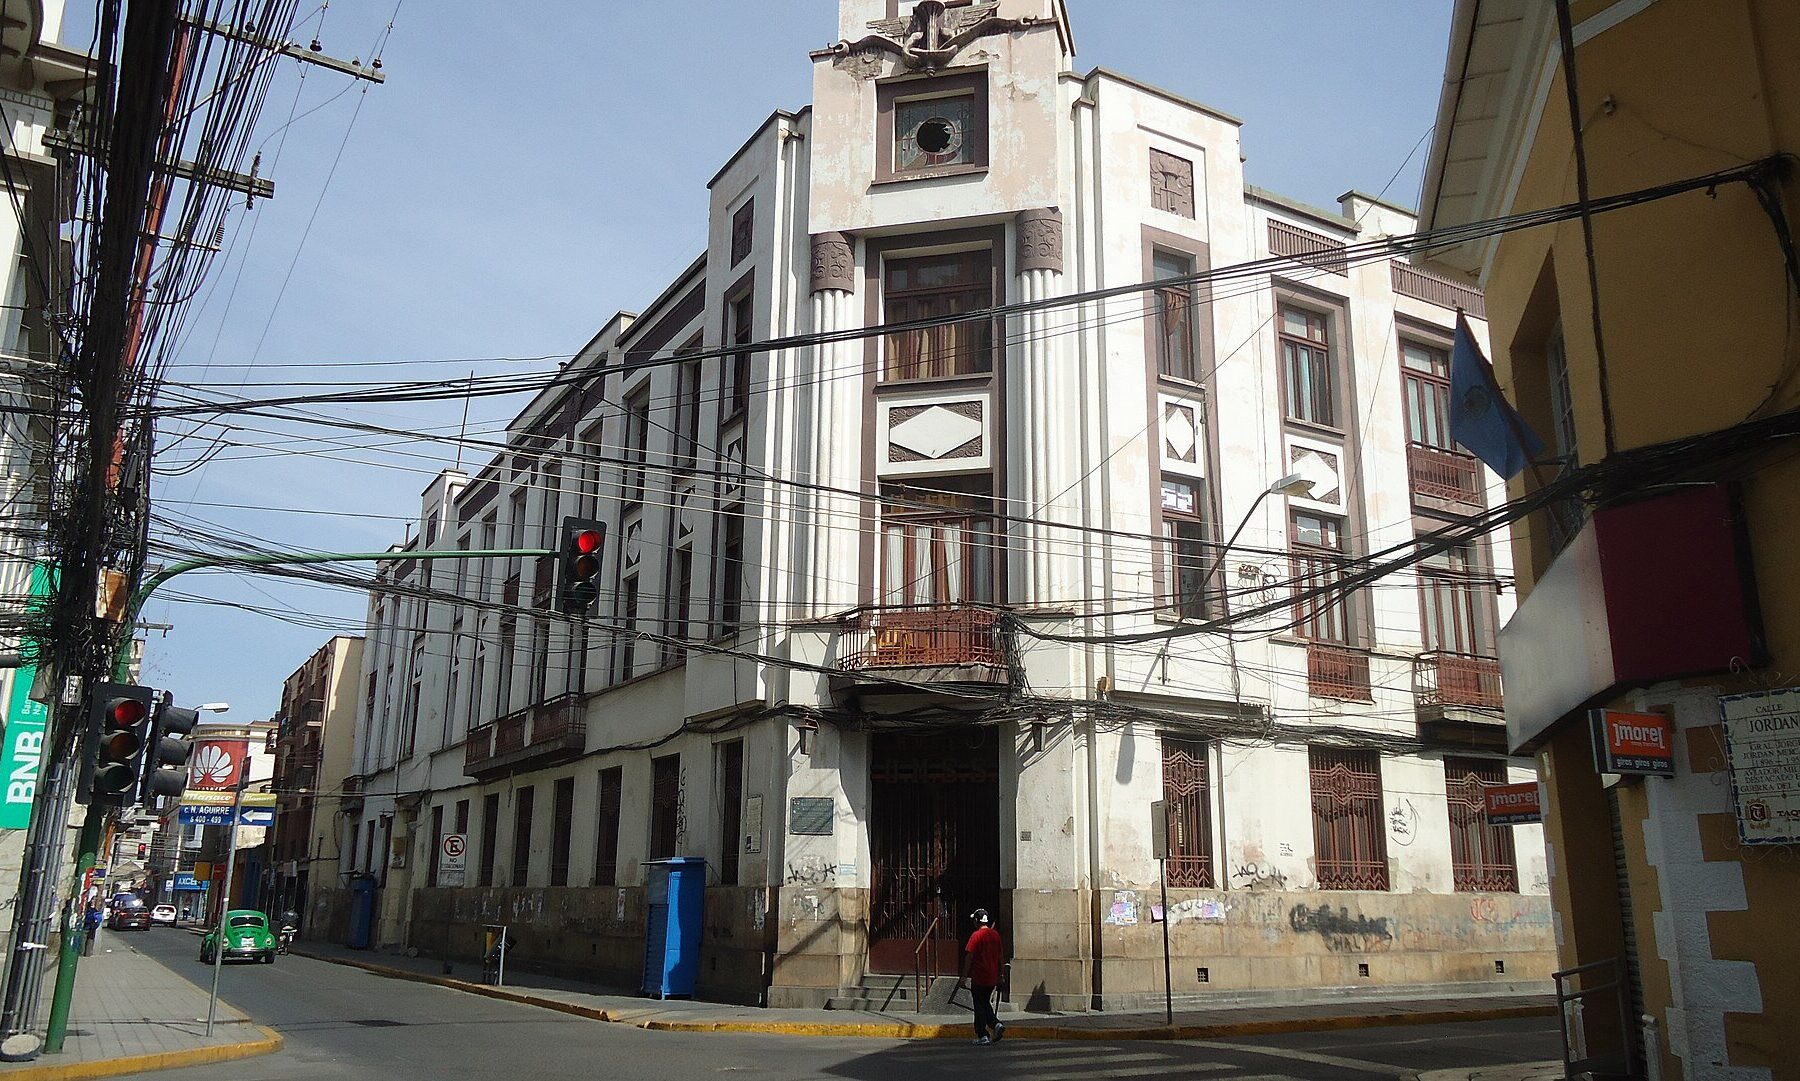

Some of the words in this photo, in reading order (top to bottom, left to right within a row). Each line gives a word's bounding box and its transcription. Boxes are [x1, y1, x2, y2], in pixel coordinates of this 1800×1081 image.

[1755, 703, 1783, 713] CALLE
[1749, 715, 1800, 733] JORDAN
[6, 732, 45, 804] BNB
[1616, 758, 1632, 768] giros
[1634, 760, 1650, 768] giros
[1652, 761, 1669, 770] giros
[199, 806, 230, 815] AGUIRRE
